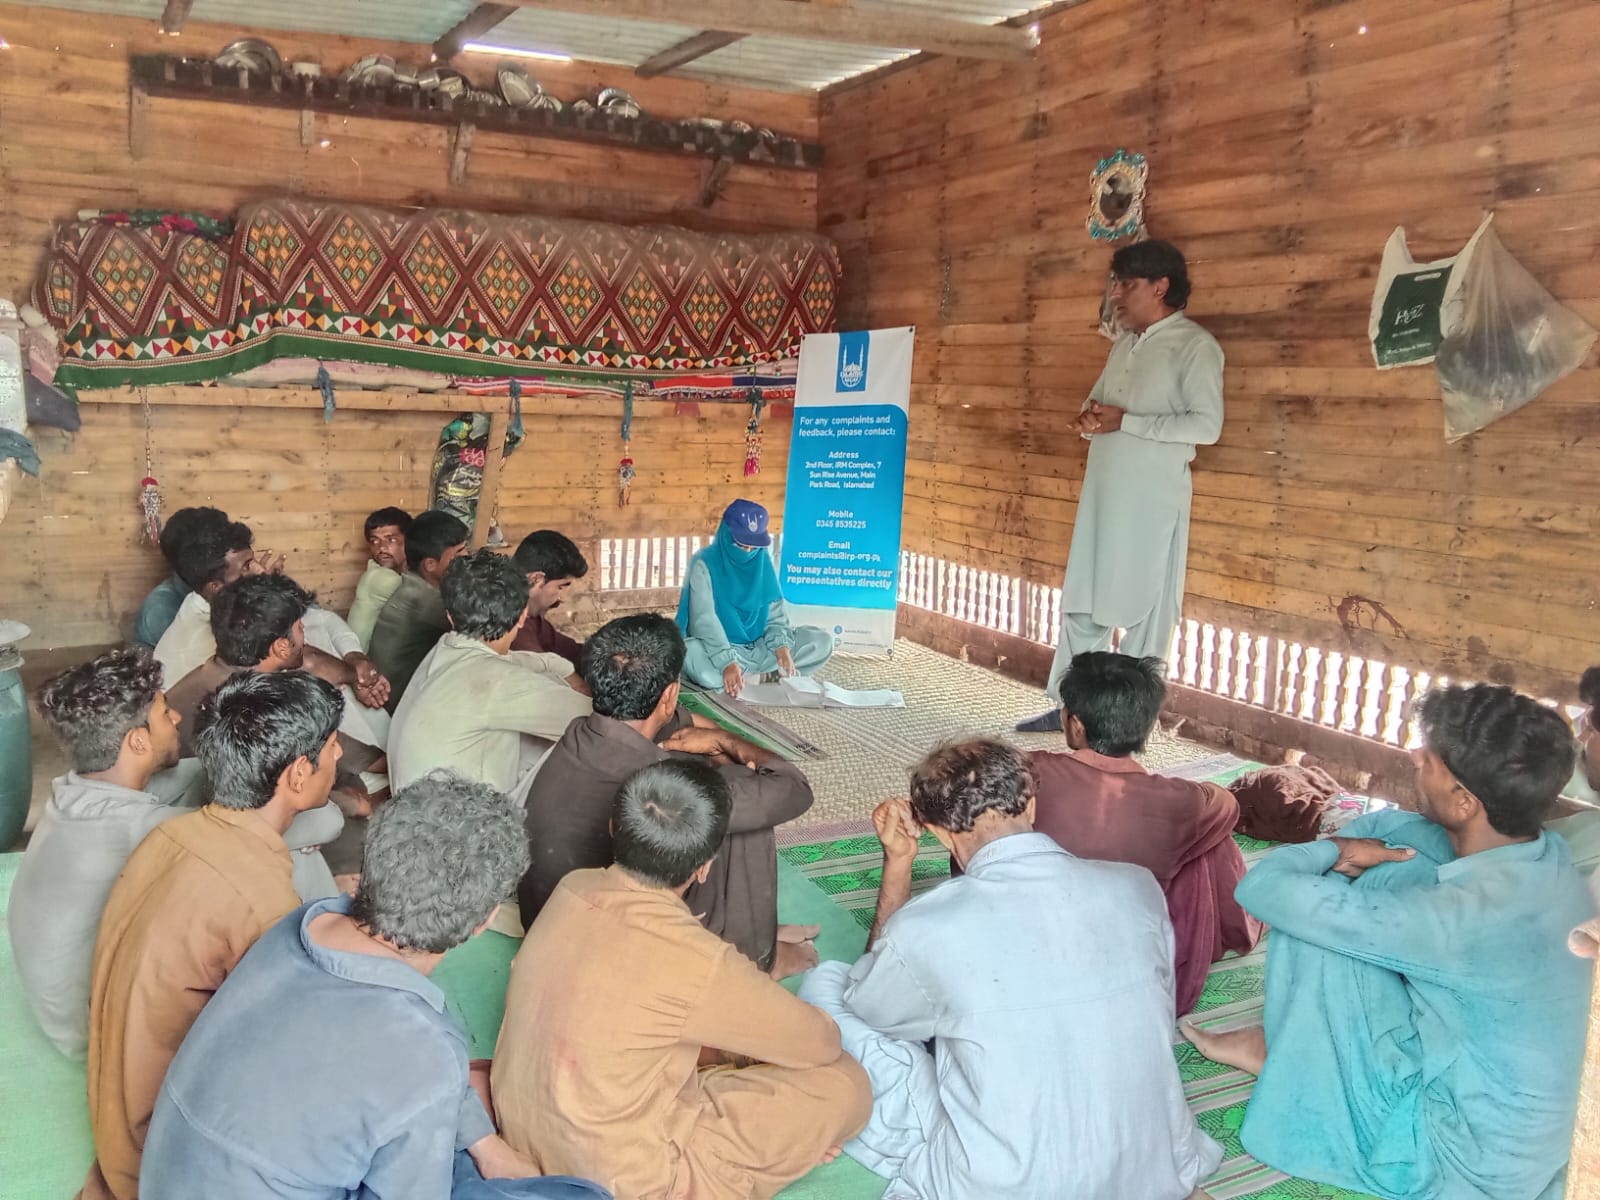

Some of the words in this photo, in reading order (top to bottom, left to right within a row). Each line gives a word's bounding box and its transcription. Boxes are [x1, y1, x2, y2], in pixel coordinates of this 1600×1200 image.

[800, 416, 813, 425] For
[814, 417, 828, 427] any
[831, 416, 874, 426] complaints
[875, 415, 890, 424] and
[799, 428, 835, 437] feedback,
[836, 429, 862, 438] please
[863, 428, 896, 436] contact:
[828, 451, 859, 459] Address
[818, 462, 834, 470] Floor,
[849, 461, 876, 470] Complex,
[809, 471, 821, 479] Sun
[836, 471, 860, 480] Avenue,
[860, 471, 876, 479] Main
[809, 481, 823, 489] Park
[824, 481, 840, 489] Road,
[843, 481, 874, 489] Islamabad
[828, 510, 854, 518] Mobile
[828, 541, 851, 549] Email
[787, 564, 802, 573] You
[803, 565, 822, 575] may
[823, 566, 841, 575] also
[843, 567, 875, 577] contact
[876, 569, 893, 578] our
[787, 575, 856, 586] representatives
[857, 577, 892, 590] directly
